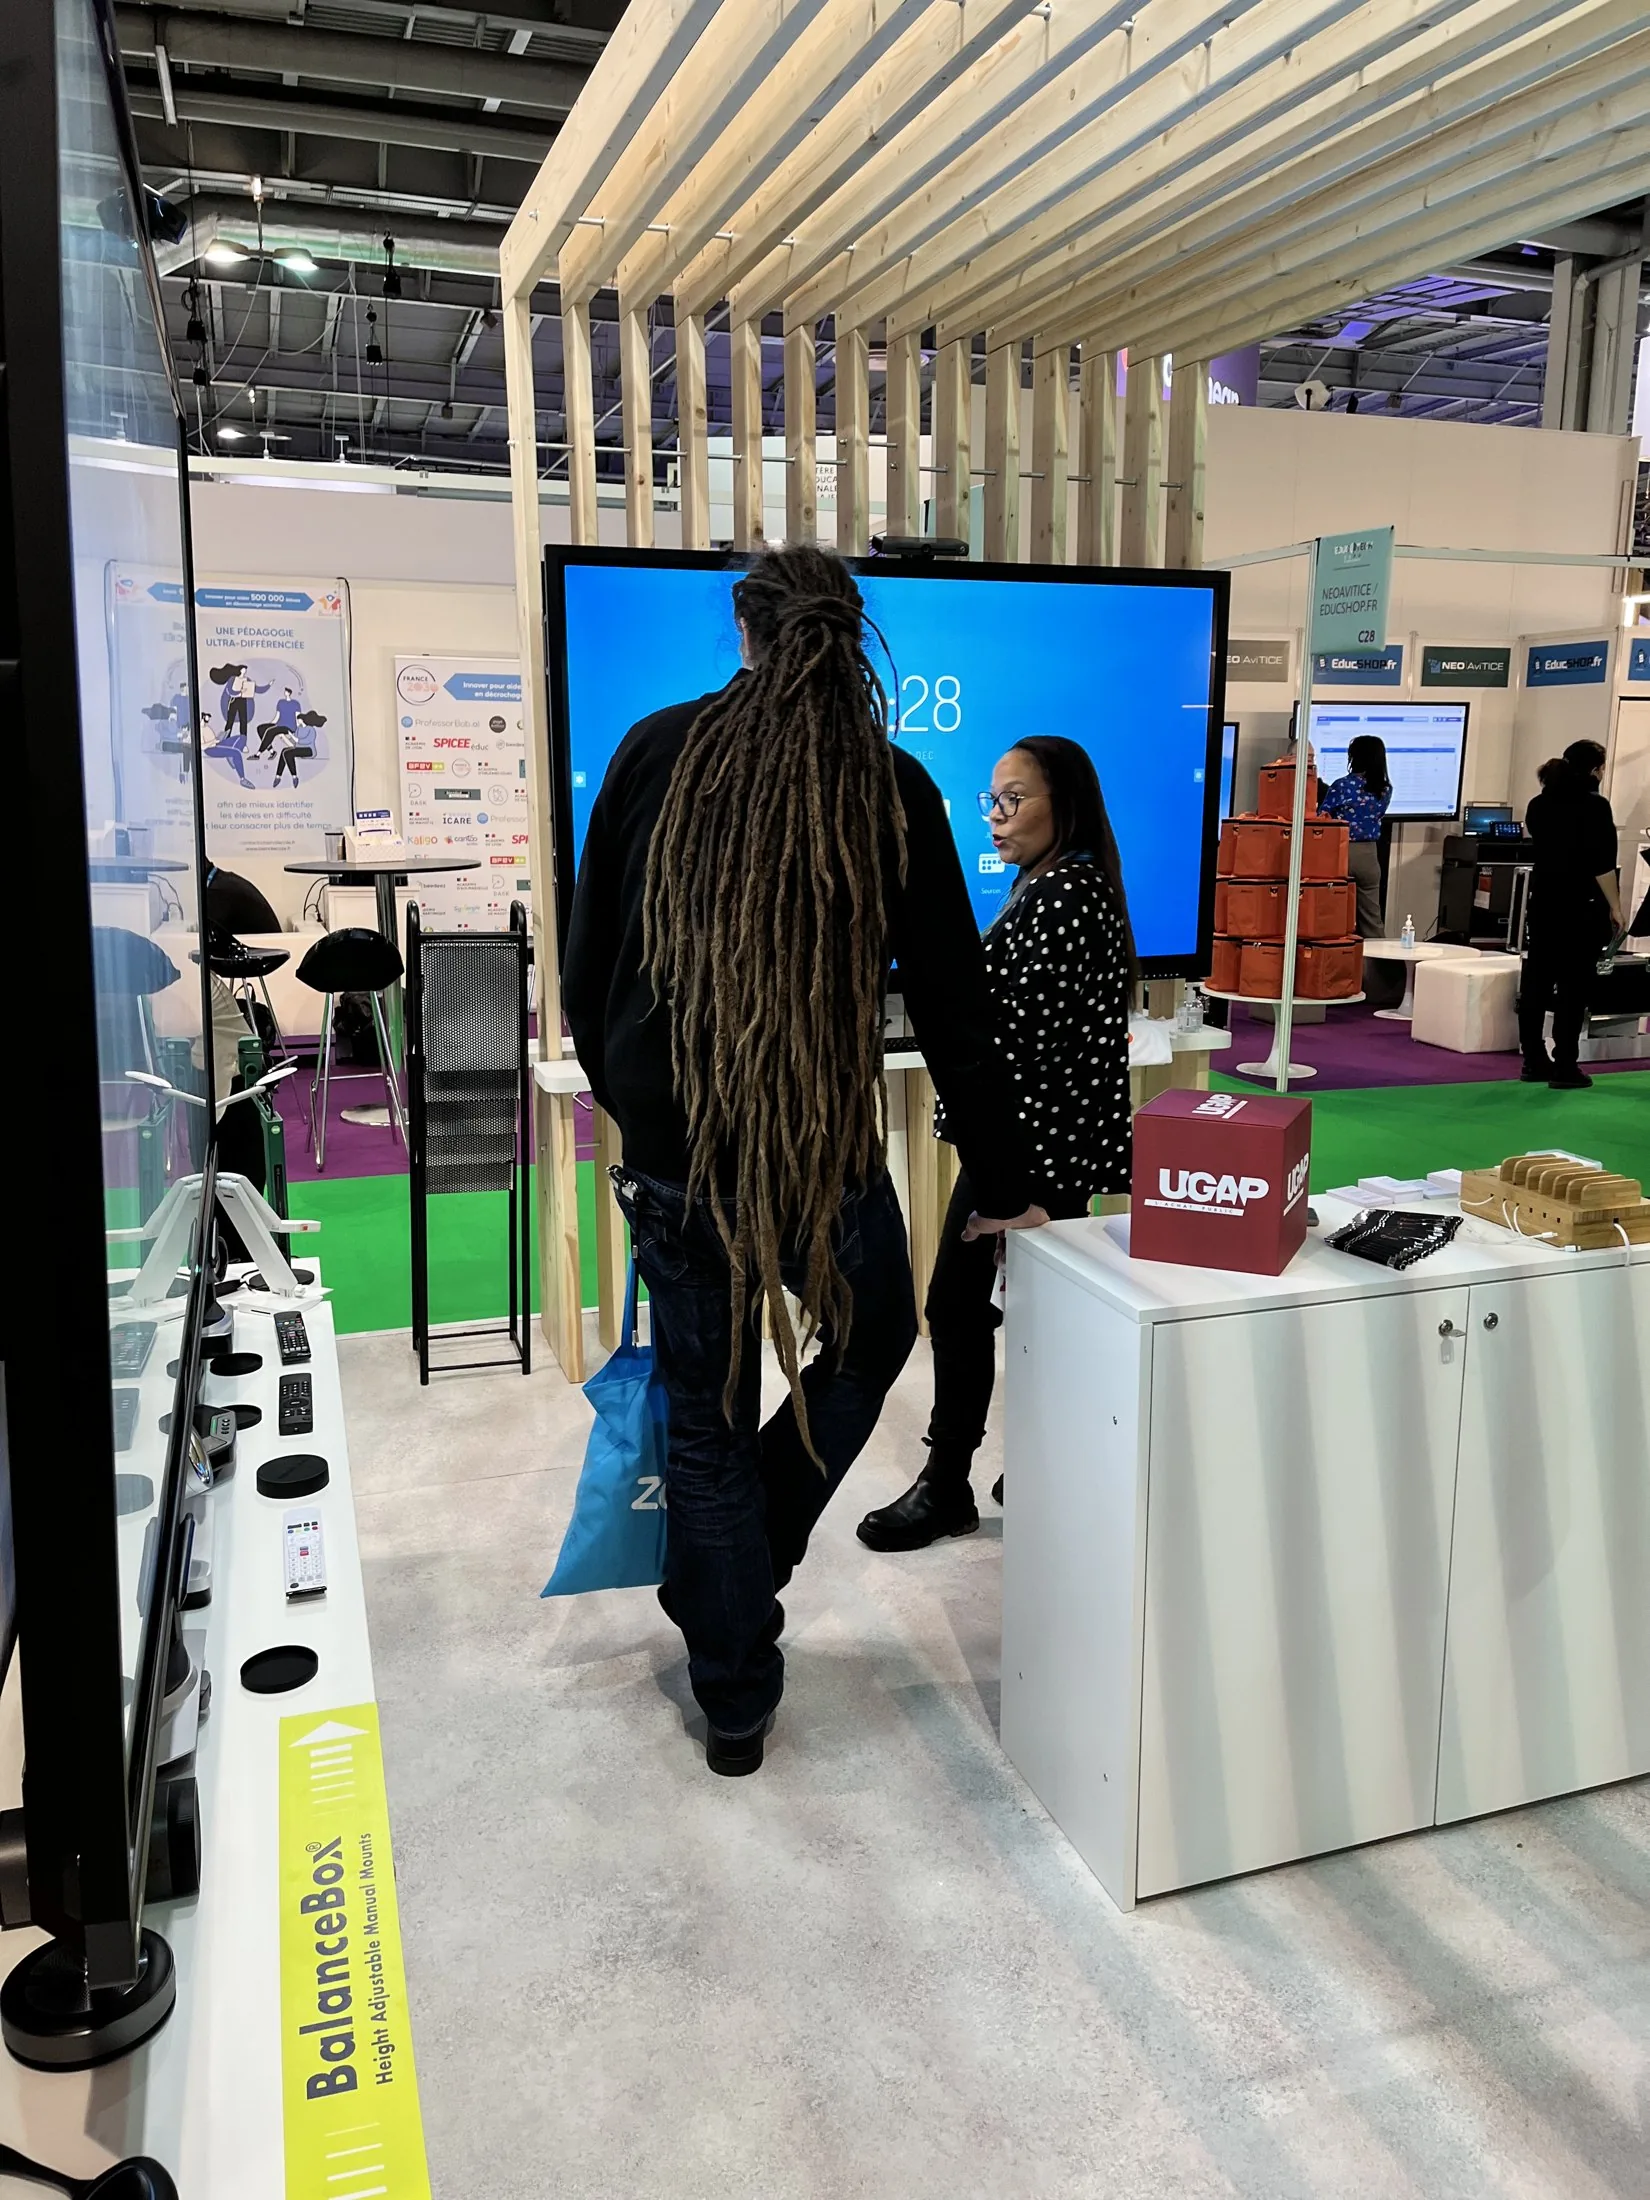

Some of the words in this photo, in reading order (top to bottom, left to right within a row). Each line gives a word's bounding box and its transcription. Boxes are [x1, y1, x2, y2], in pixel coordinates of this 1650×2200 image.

[1322, 583, 1372, 600] NEOAVITICE
[1373, 582, 1379, 594] /
[250, 593, 267, 602] 500
[268, 594, 285, 603] 000
[1320, 599, 1378, 616] EDUCSHOP.FR
[215, 626, 235, 635] UNE
[237, 625, 294, 637] PÉDAGOGIE
[1358, 630, 1375, 643] C28
[206, 638, 305, 650] ULTRA-DIFFÉRENCIÉE
[1226, 655, 1241, 664] EO
[1331, 658, 1397, 670] EducSHOP.fr
[1441, 661, 1465, 670] NEO
[1544, 656, 1603, 671] EducSHOP.fr
[463, 681, 488, 689] Innover
[888, 675, 962, 732] :28
[433, 738, 472, 749] SPICEE
[217, 800, 233, 809] afin
[235, 801, 247, 809] de
[249, 801, 275, 809] mieux
[276, 800, 314, 809] identifier
[234, 811, 261, 819] élèves
[278, 811, 312, 819] difficulté
[443, 817, 472, 825] ICARE
[211, 822, 227, 830] leur
[273, 822, 292, 832] plus
[294, 822, 304, 830] de
[407, 835, 438, 846] Kaligo
[511, 834, 528, 845] SPI
[1191, 1093, 1238, 1116] UGAP
[1286, 1152, 1310, 1202] UGAP
[1159, 1167, 1270, 1206] UGAP
[1201, 1206, 1234, 1214] PUBLIC
[359, 1832, 375, 1879] Mounts
[359, 1884, 380, 1936] Manual
[364, 1940, 390, 2022] Adjustable
[373, 2029, 395, 2086] Height
